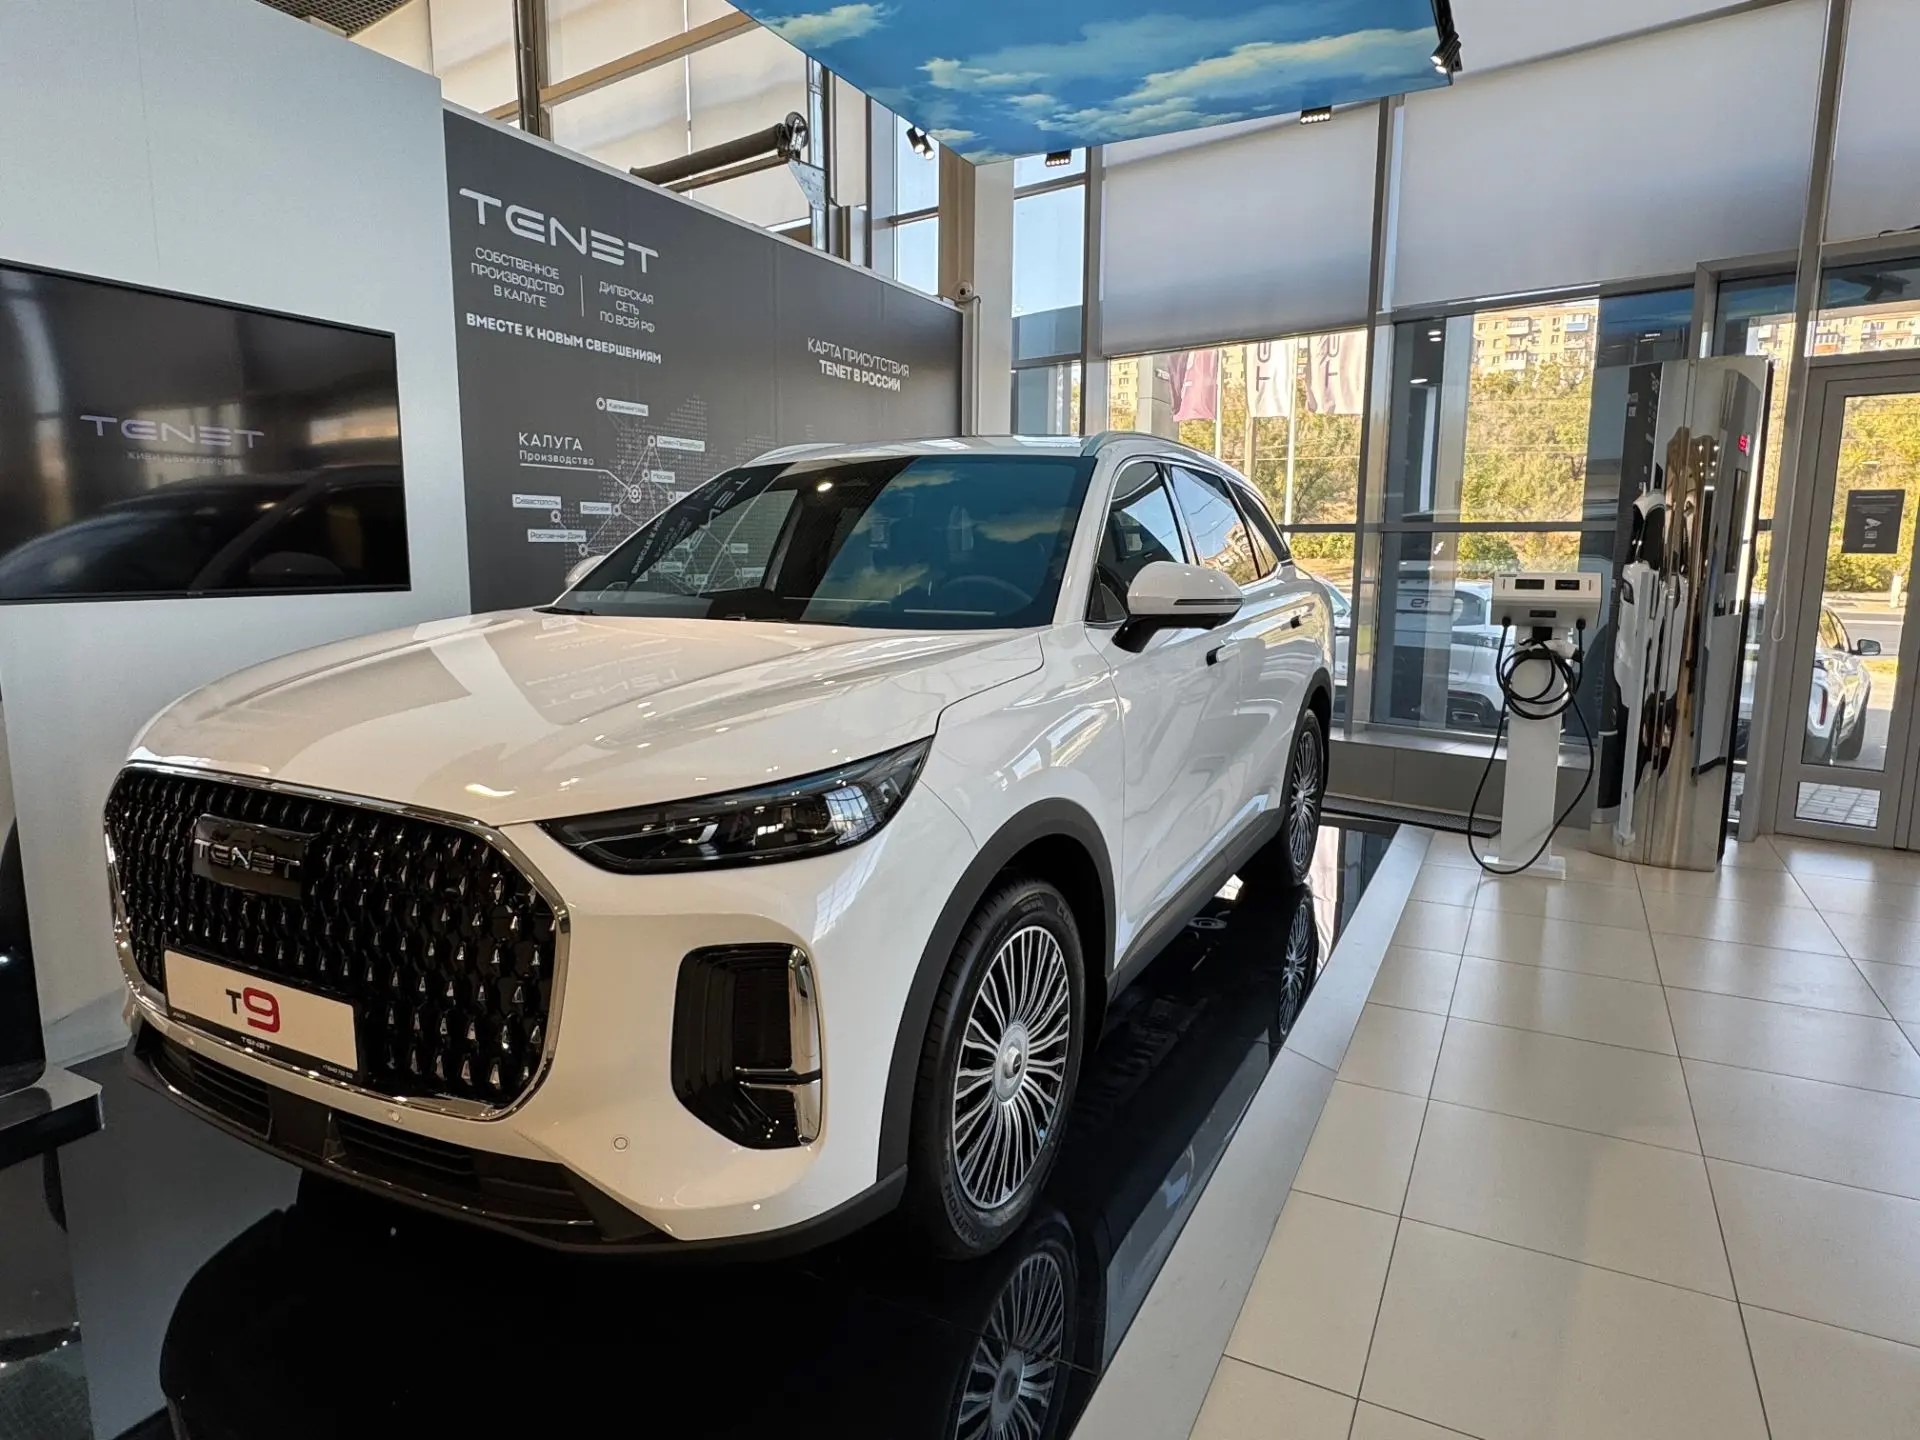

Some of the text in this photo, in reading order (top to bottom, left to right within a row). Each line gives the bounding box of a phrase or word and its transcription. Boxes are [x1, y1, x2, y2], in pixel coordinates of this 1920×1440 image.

[459, 187, 659, 273] TENET
[471, 262, 565, 296] ПРОИЗВОДСТВО
[475, 247, 559, 280] СОБСТВЕННОЕ
[494, 285, 547, 308] В КАЛУГЕ
[599, 281, 654, 304] ДИЛЕРСКАЯ
[615, 300, 639, 315] СЕТЬ
[466, 312, 662, 364] ВМЕСТЕ К НОВЫМ СВЕРШЕНИЯМ
[600, 311, 655, 333] ПО ВСЕЙ РФ
[807, 337, 910, 377] КАРТА ПРИСУТСТВИЯ
[819, 359, 901, 392] TENET В РОССИИ
[80, 414, 264, 448] TENET
[519, 431, 583, 451] КАЛУГА
[519, 450, 594, 466] Производство
[194, 838, 300, 878] TENET
[225, 986, 280, 1033] T9
[240, 1036, 272, 1051] TENET
